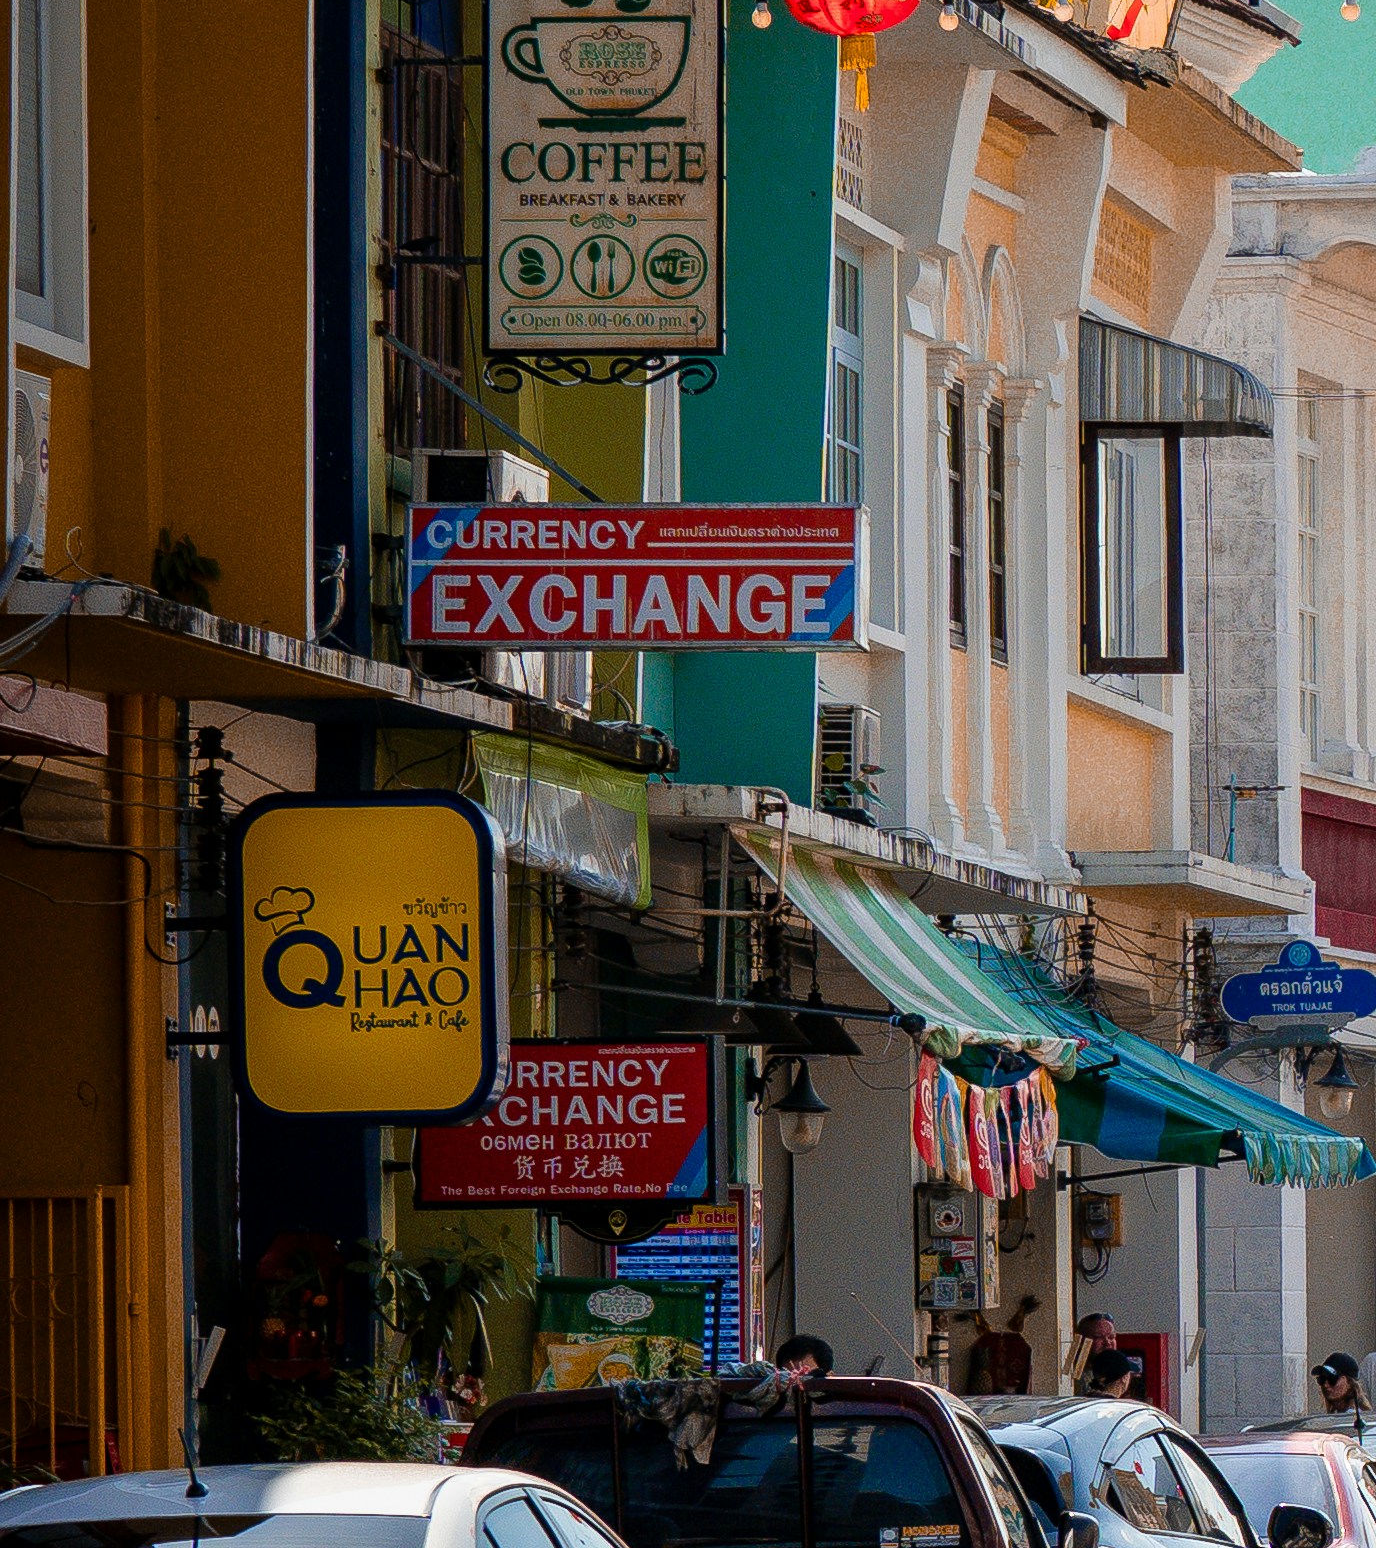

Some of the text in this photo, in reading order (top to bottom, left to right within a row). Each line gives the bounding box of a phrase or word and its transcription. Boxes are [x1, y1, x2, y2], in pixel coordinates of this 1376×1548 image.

[578, 42, 647, 61] ROSE
[578, 60, 646, 69] ESPRESSO
[566, 87, 657, 97] OLD TOWN PHUKET
[500, 141, 709, 184] COFFEE
[519, 193, 687, 207] BREAKFAST & BAKERY
[521, 312, 561, 328] Open
[565, 312, 656, 327] 08.00-06.00
[426, 520, 645, 550] CURRENCY
[431, 573, 831, 635] EXCHANGE
[402, 896, 468, 918] ขวัญข้าว
[353, 966, 470, 1008] HAO
[1272, 1001, 1333, 1012] TROK TUAJAE
[350, 1011, 420, 1032] Restaurant
[438, 1009, 470, 1032] Cafe
[512, 1154, 626, 1181] 货币兑换
[440, 1185, 464, 1196] The
[468, 1185, 496, 1196] Best
[500, 1184, 546, 1198] Foreign
[551, 1184, 609, 1198] Exchange
[666, 1182, 688, 1193] Fee
[699, 1210, 737, 1224] Table
